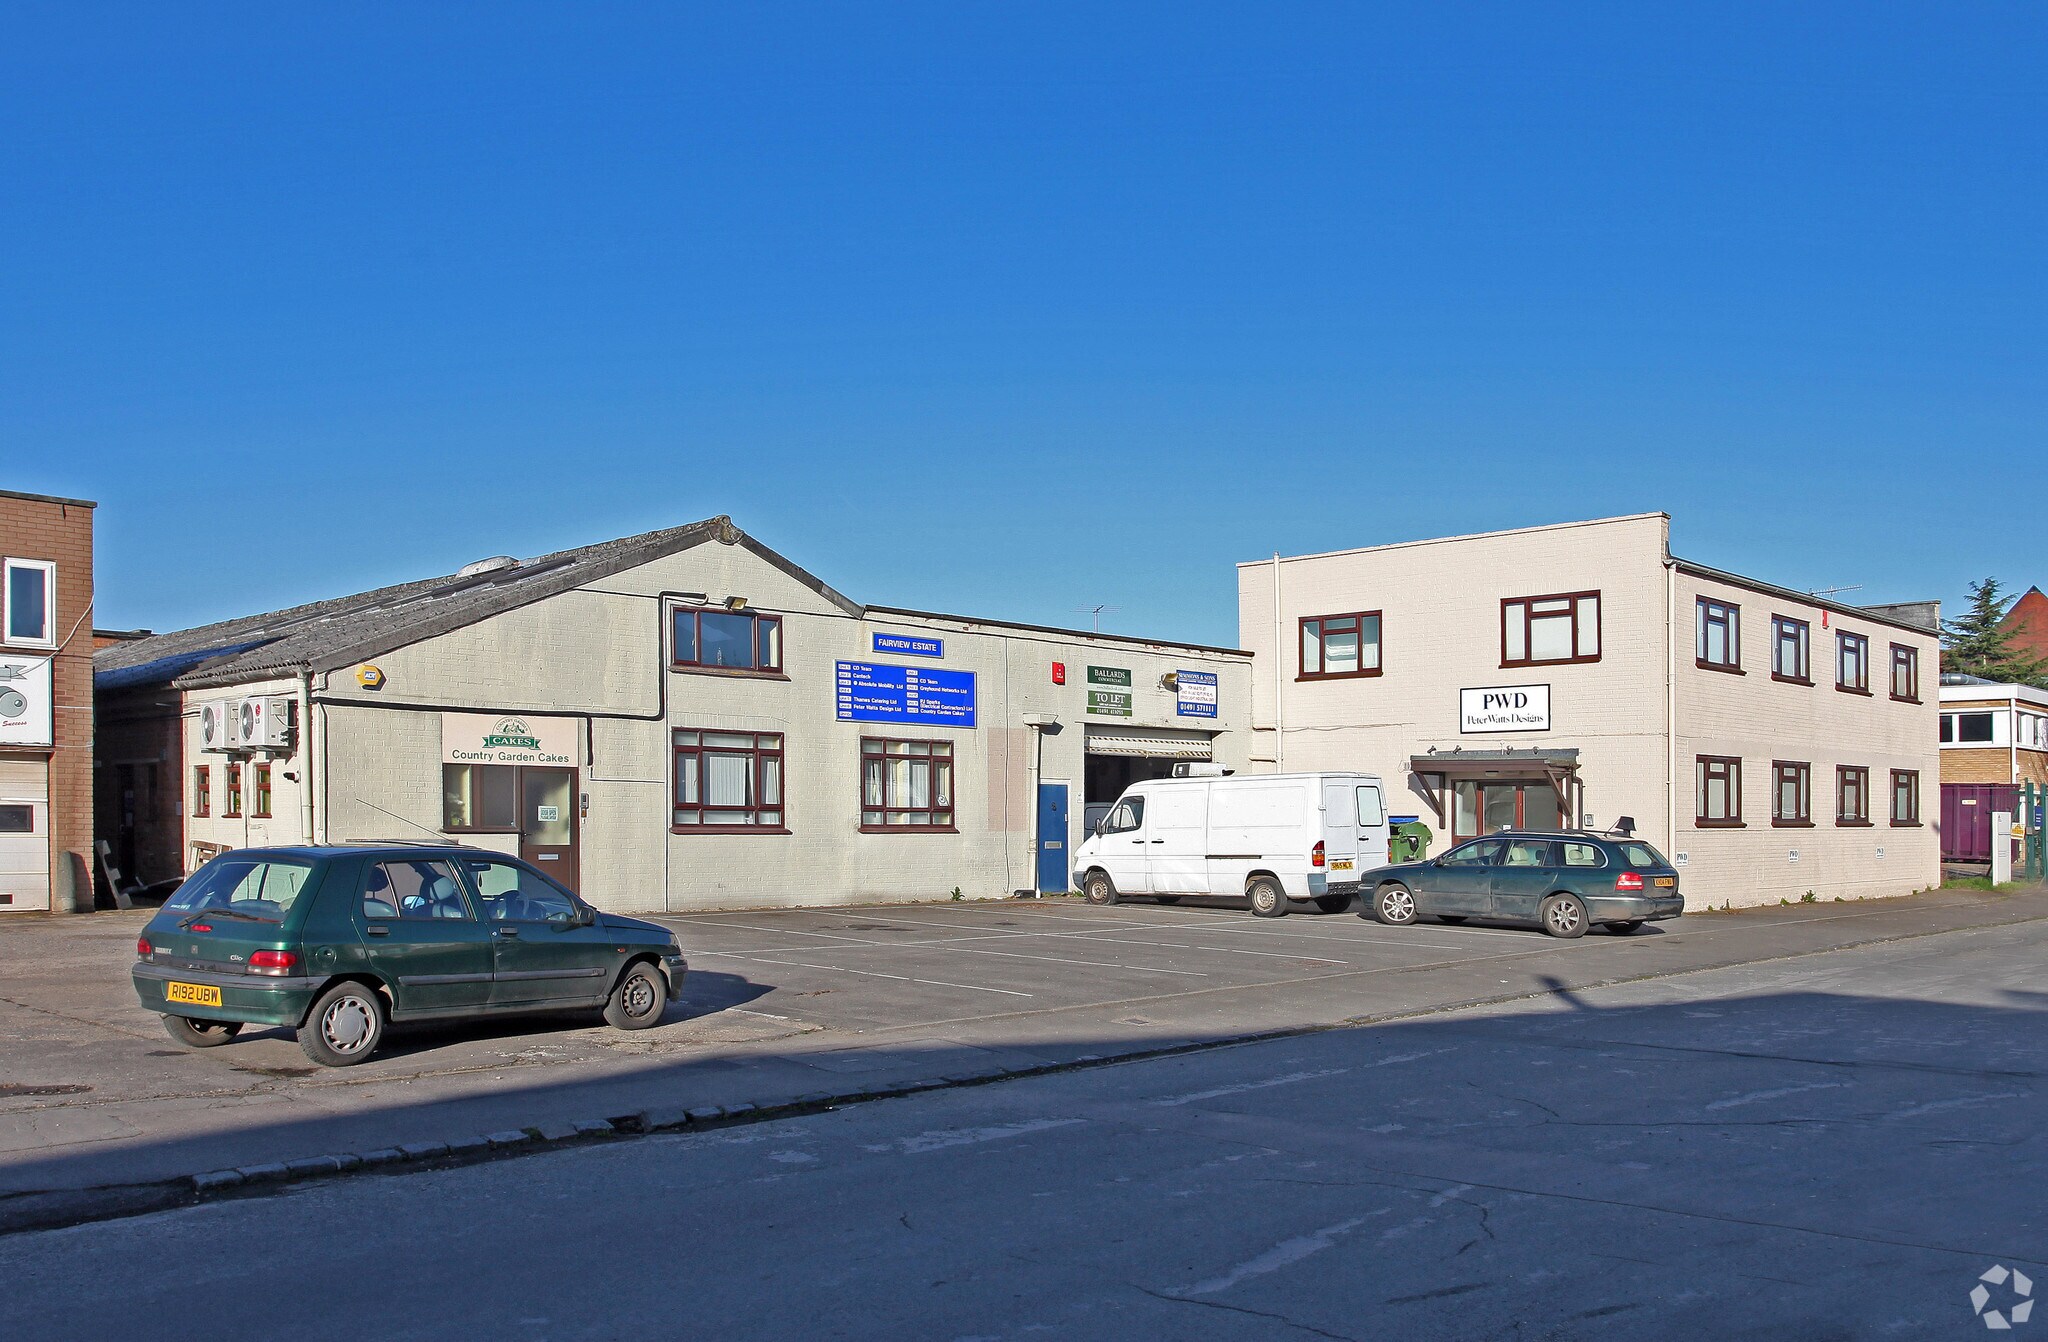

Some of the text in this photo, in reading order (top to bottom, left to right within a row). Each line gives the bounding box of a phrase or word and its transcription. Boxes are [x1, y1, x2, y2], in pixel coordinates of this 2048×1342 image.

[878, 638, 937, 651] FAIRVIEW ESTATE
[1094, 669, 1126, 679] BALLARDS
[1094, 692, 1126, 704] TO LET
[1483, 692, 1528, 710] PWD
[1467, 713, 1544, 725] Peter Watts Designs
[492, 737, 532, 746] CAKES
[452, 750, 570, 762] Country Garden Cakes
[172, 984, 218, 1003] R192 UBW
